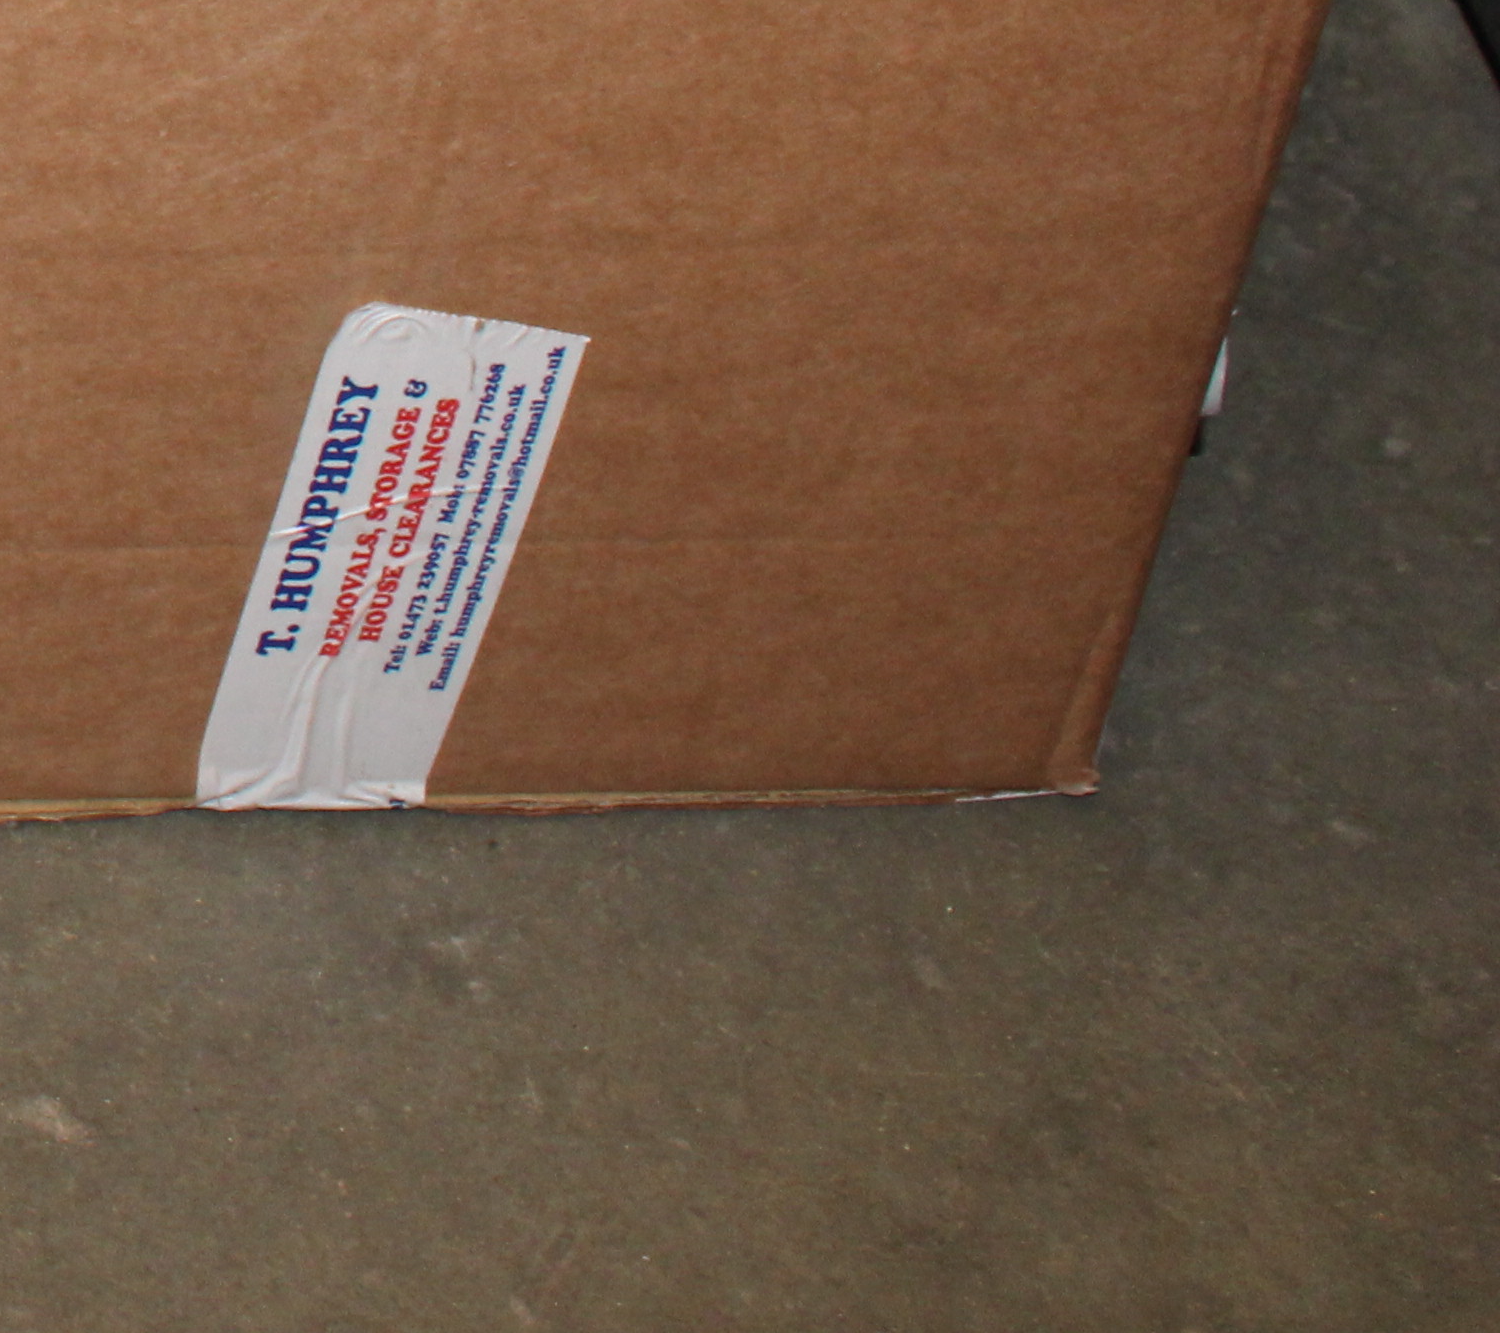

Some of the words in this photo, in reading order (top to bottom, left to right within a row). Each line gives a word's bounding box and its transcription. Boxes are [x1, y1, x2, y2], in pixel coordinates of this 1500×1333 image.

[271, 376, 378, 613] HUMPHREY
[320, 526, 384, 658] REMOVALS,
[365, 406, 421, 523] STORAGE
[404, 379, 428, 399] &
[358, 565, 404, 643] HOUSE
[390, 398, 460, 558] CLEARANCES
[384, 644, 406, 674] Tel:
[438, 484, 464, 525] Mob:
[256, 624, 300, 656] T.
[416, 616, 445, 656] Web:
[429, 642, 462, 692] Email:
